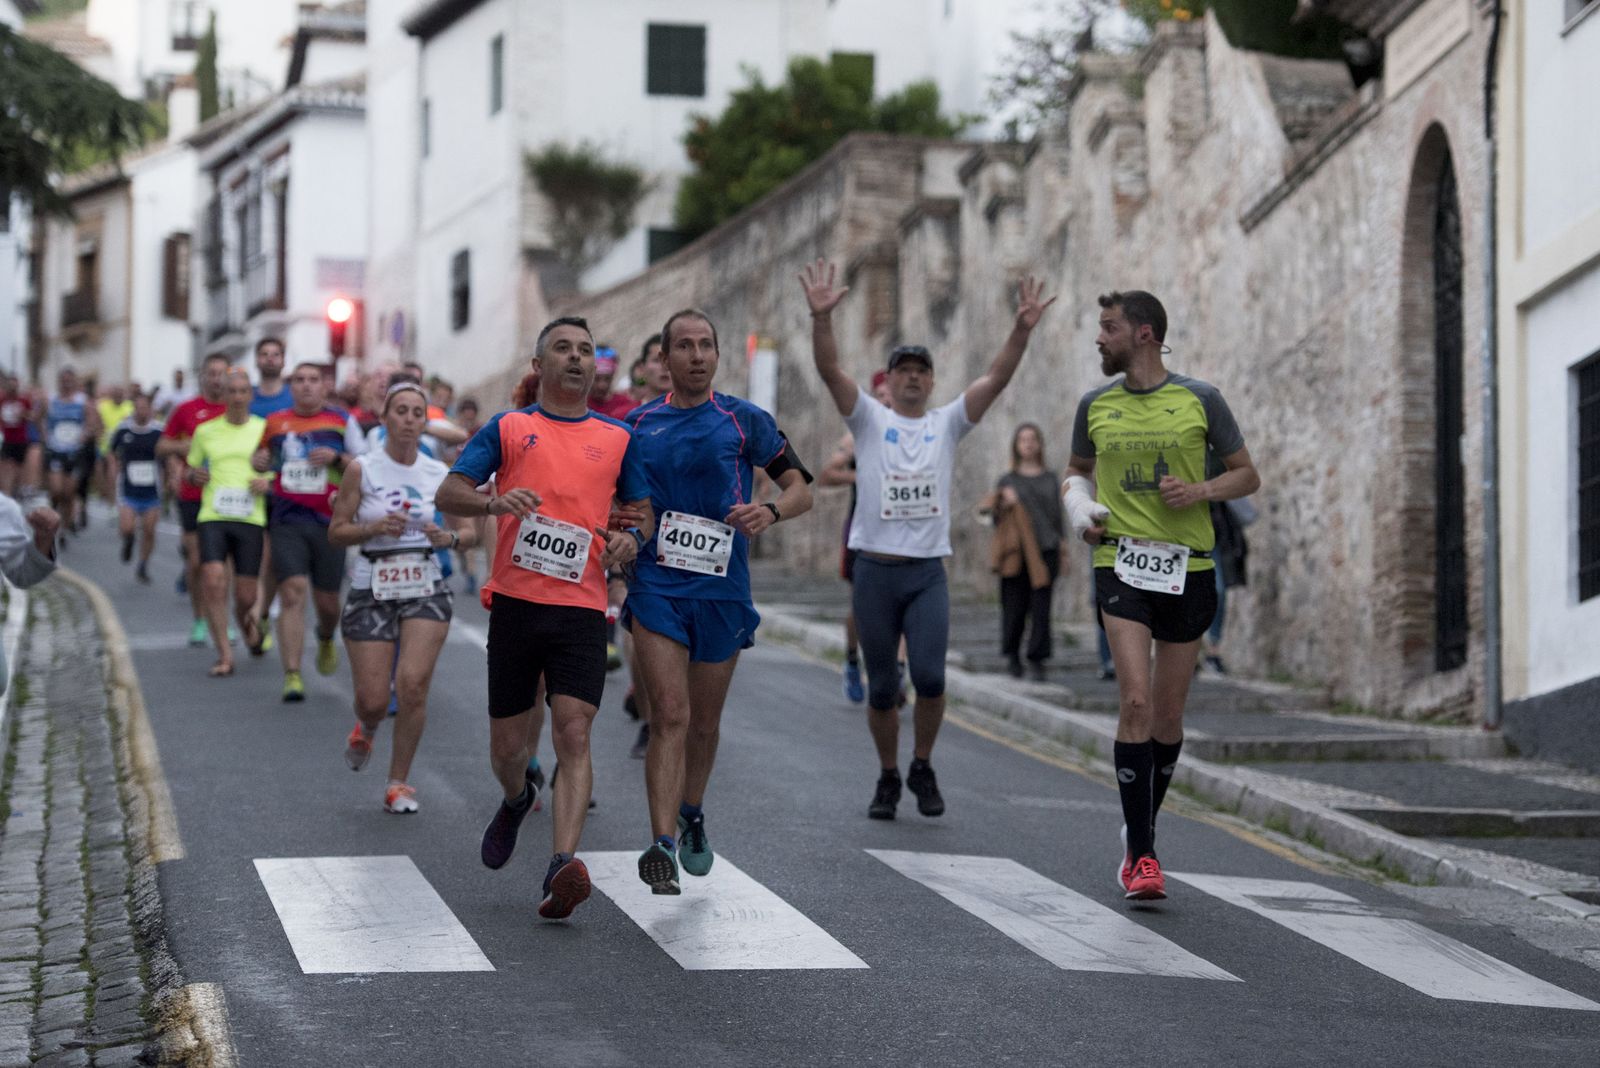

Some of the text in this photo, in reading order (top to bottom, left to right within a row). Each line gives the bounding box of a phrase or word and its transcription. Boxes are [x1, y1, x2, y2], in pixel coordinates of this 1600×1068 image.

[1106, 440, 1179, 451] DE SEVILLA
[889, 485, 931, 501] 3614
[523, 530, 577, 559] 4008
[665, 528, 721, 553] 4007
[1122, 552, 1174, 575] 4033
[378, 567, 422, 583] 5215
